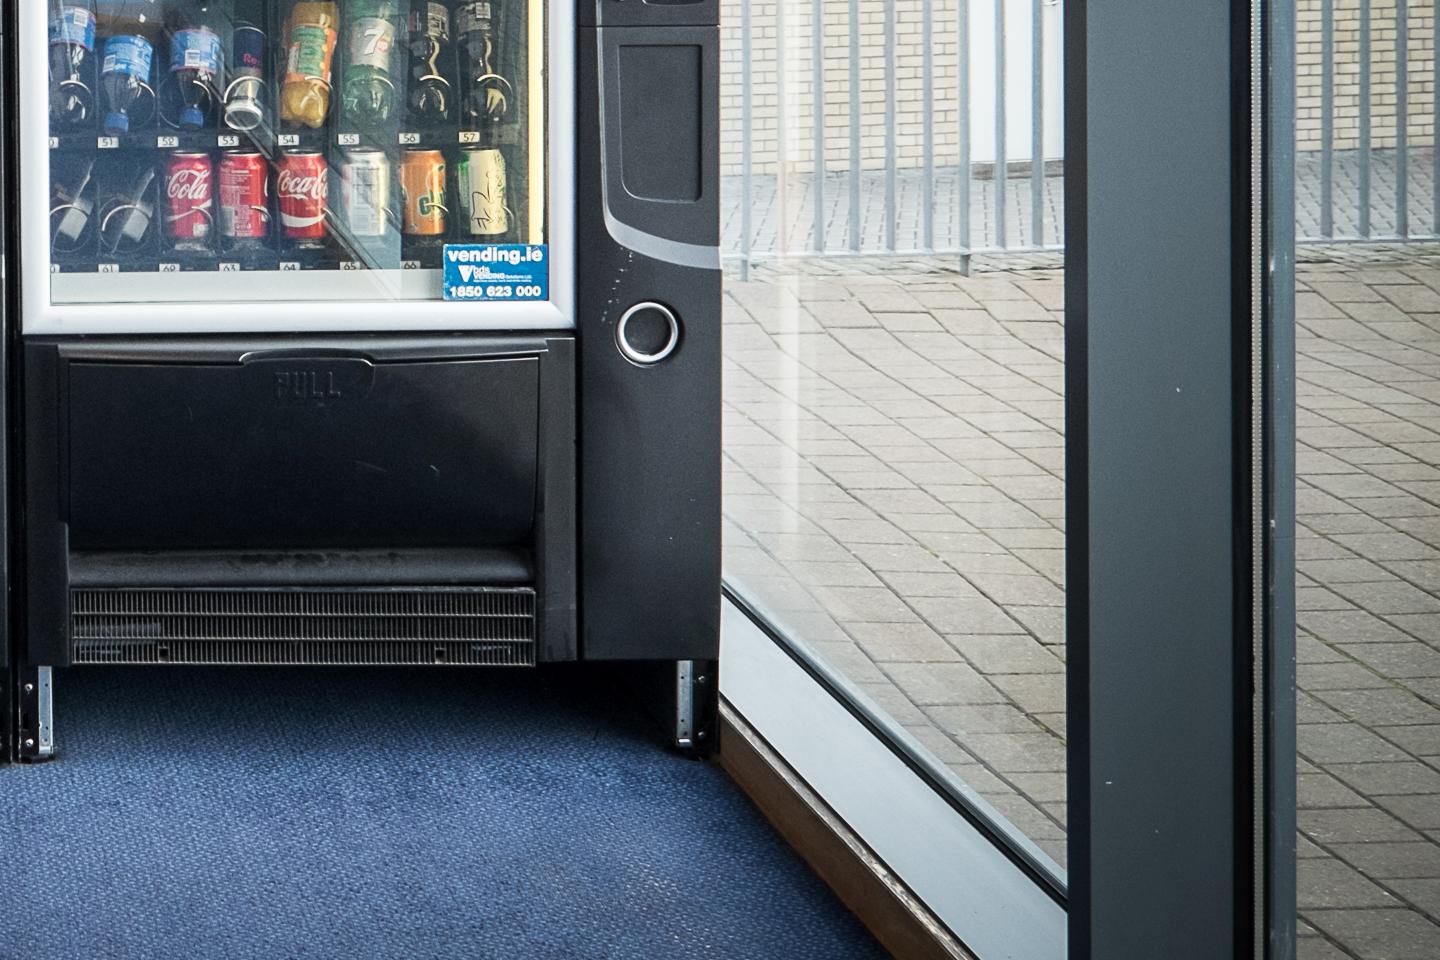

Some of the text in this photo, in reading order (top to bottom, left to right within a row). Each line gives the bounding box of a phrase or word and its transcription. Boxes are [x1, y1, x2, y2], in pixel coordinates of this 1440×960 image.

[448, 247, 543, 265] vending.ie
[450, 286, 541, 297] 1850 623 000
